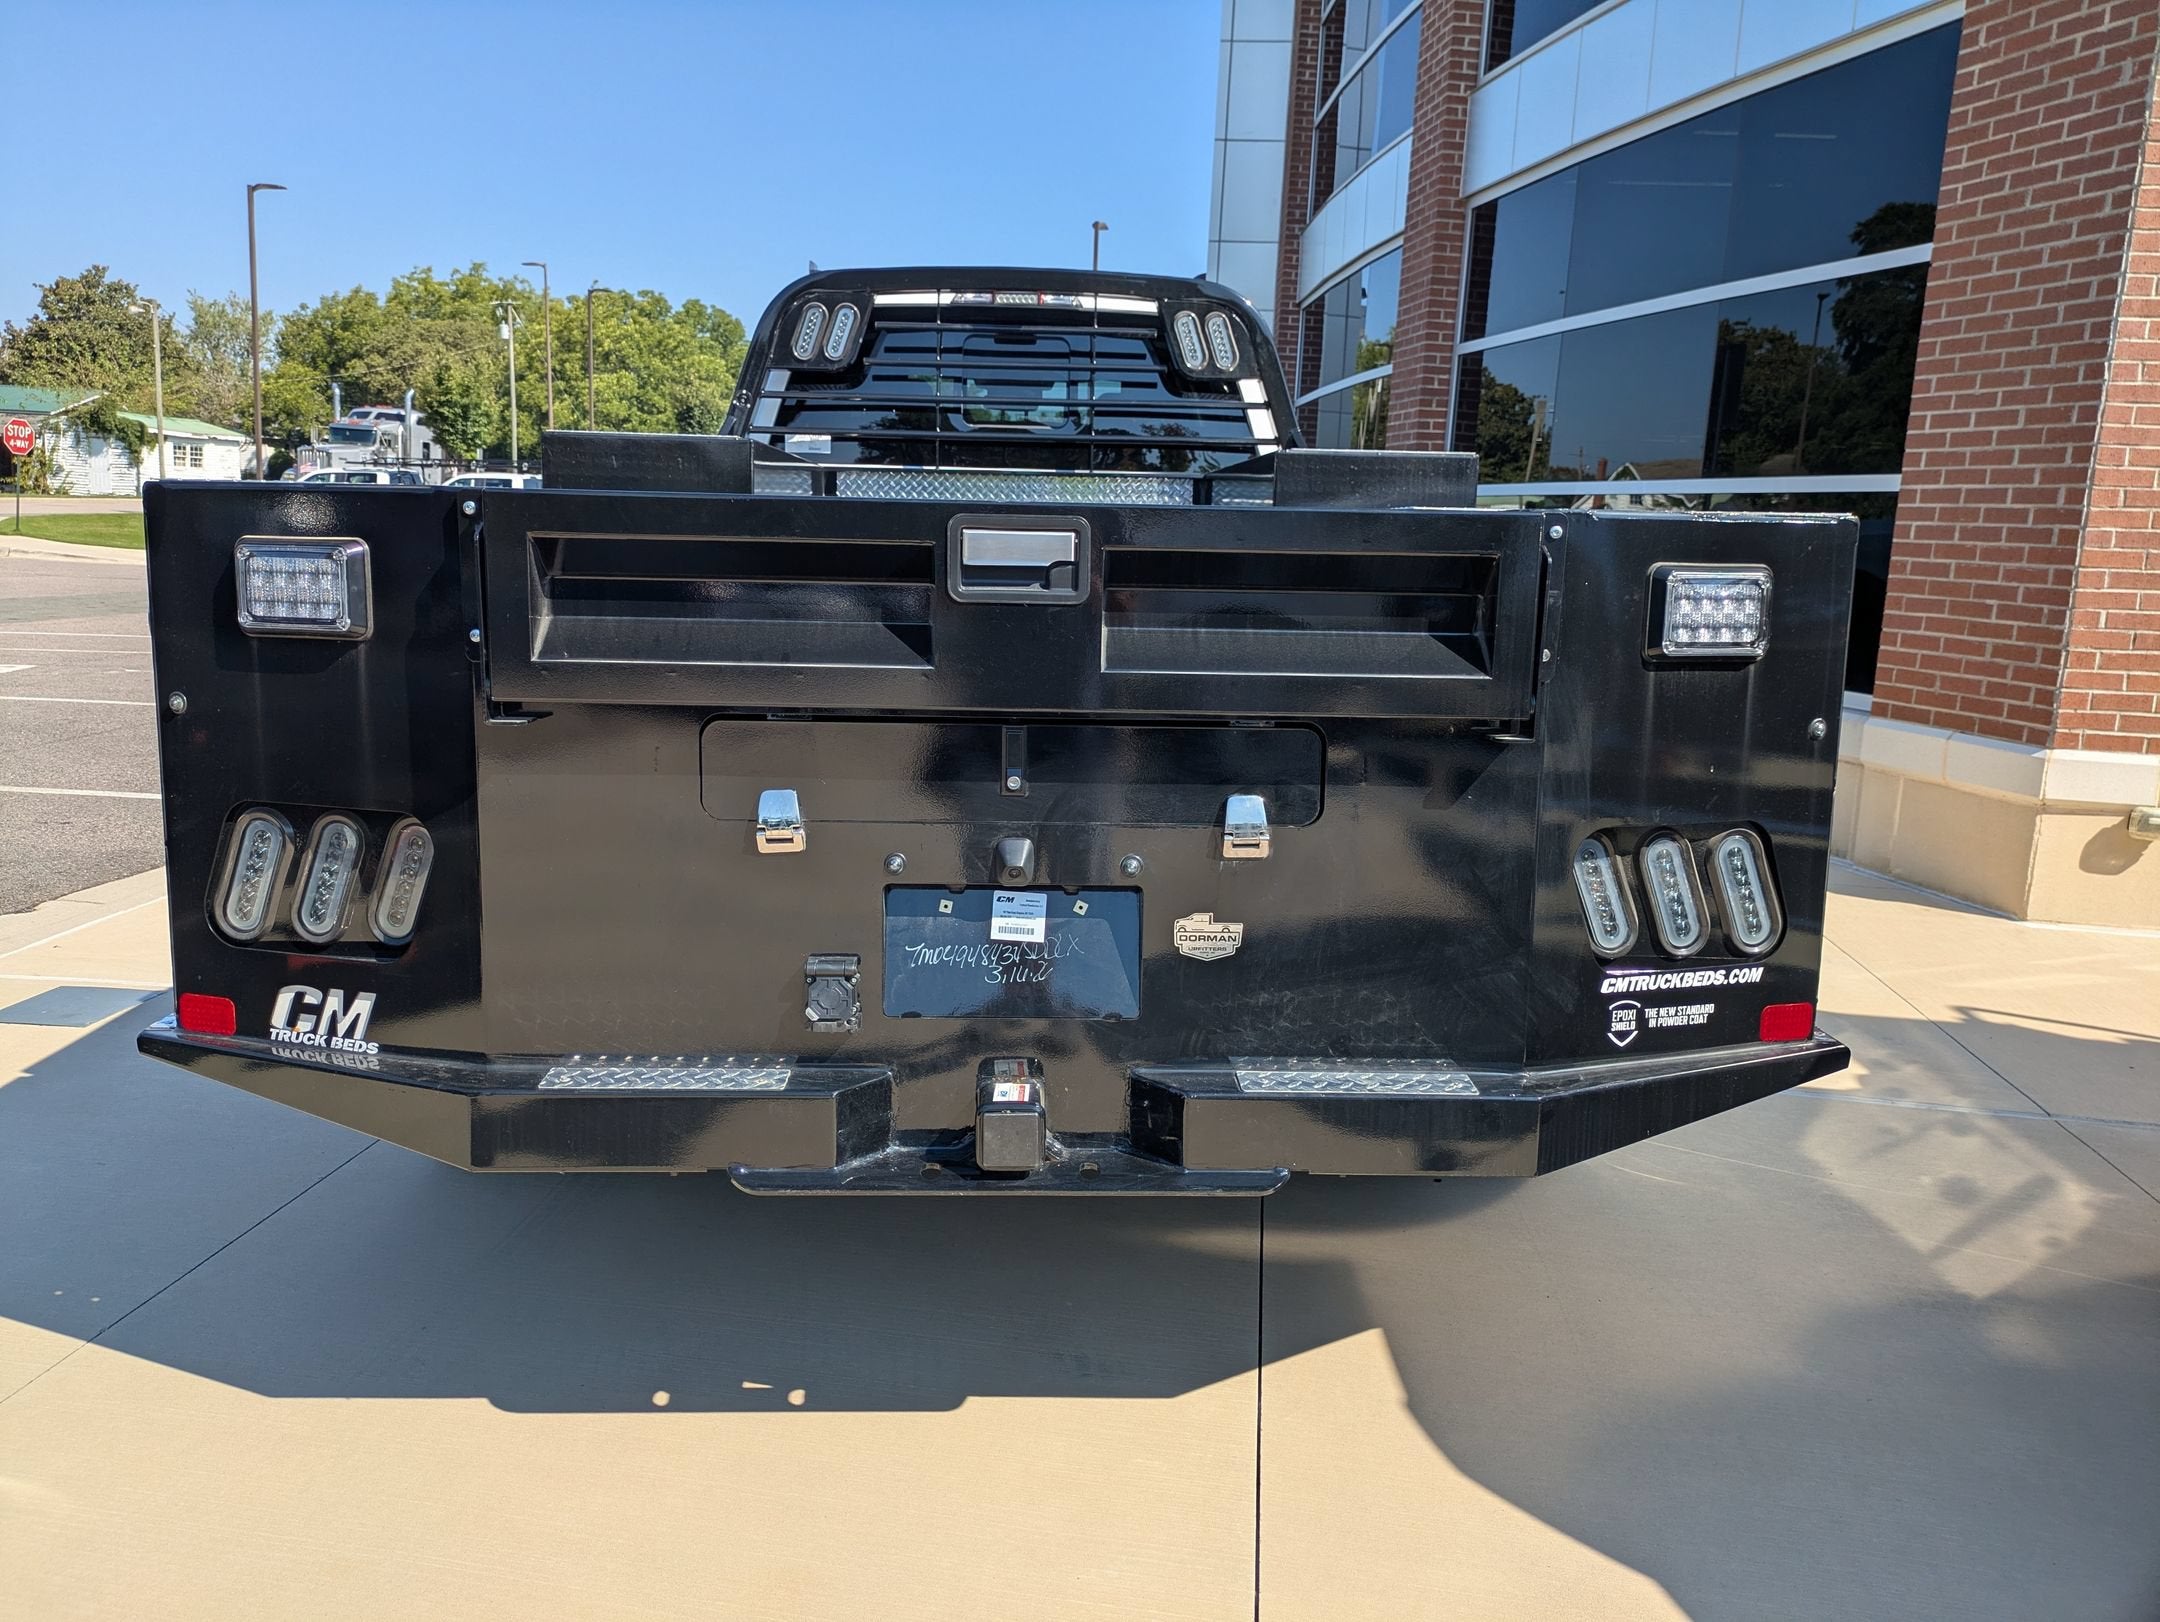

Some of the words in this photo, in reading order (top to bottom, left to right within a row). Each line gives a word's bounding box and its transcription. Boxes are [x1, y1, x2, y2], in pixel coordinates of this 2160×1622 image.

[7, 424, 31, 438] STOP
[9, 439, 29, 448] 4-WAY
[1601, 967, 1764, 994] CMTRUCKBEDS.COM
[270, 985, 377, 1041] CM
[1612, 1009, 1637, 1022] EPOXI
[1644, 1008, 1658, 1018] THE
[1660, 1006, 1676, 1017] NEW
[1677, 1003, 1715, 1015] STANDARD
[1611, 1021, 1636, 1031] SHIELD
[1648, 1018, 1656, 1028] IN
[1657, 1015, 1688, 1027] POWDER
[1689, 1014, 1708, 1025] COAT
[270, 1028, 328, 1048] TRUCK
[330, 1036, 379, 1054] BEDS
